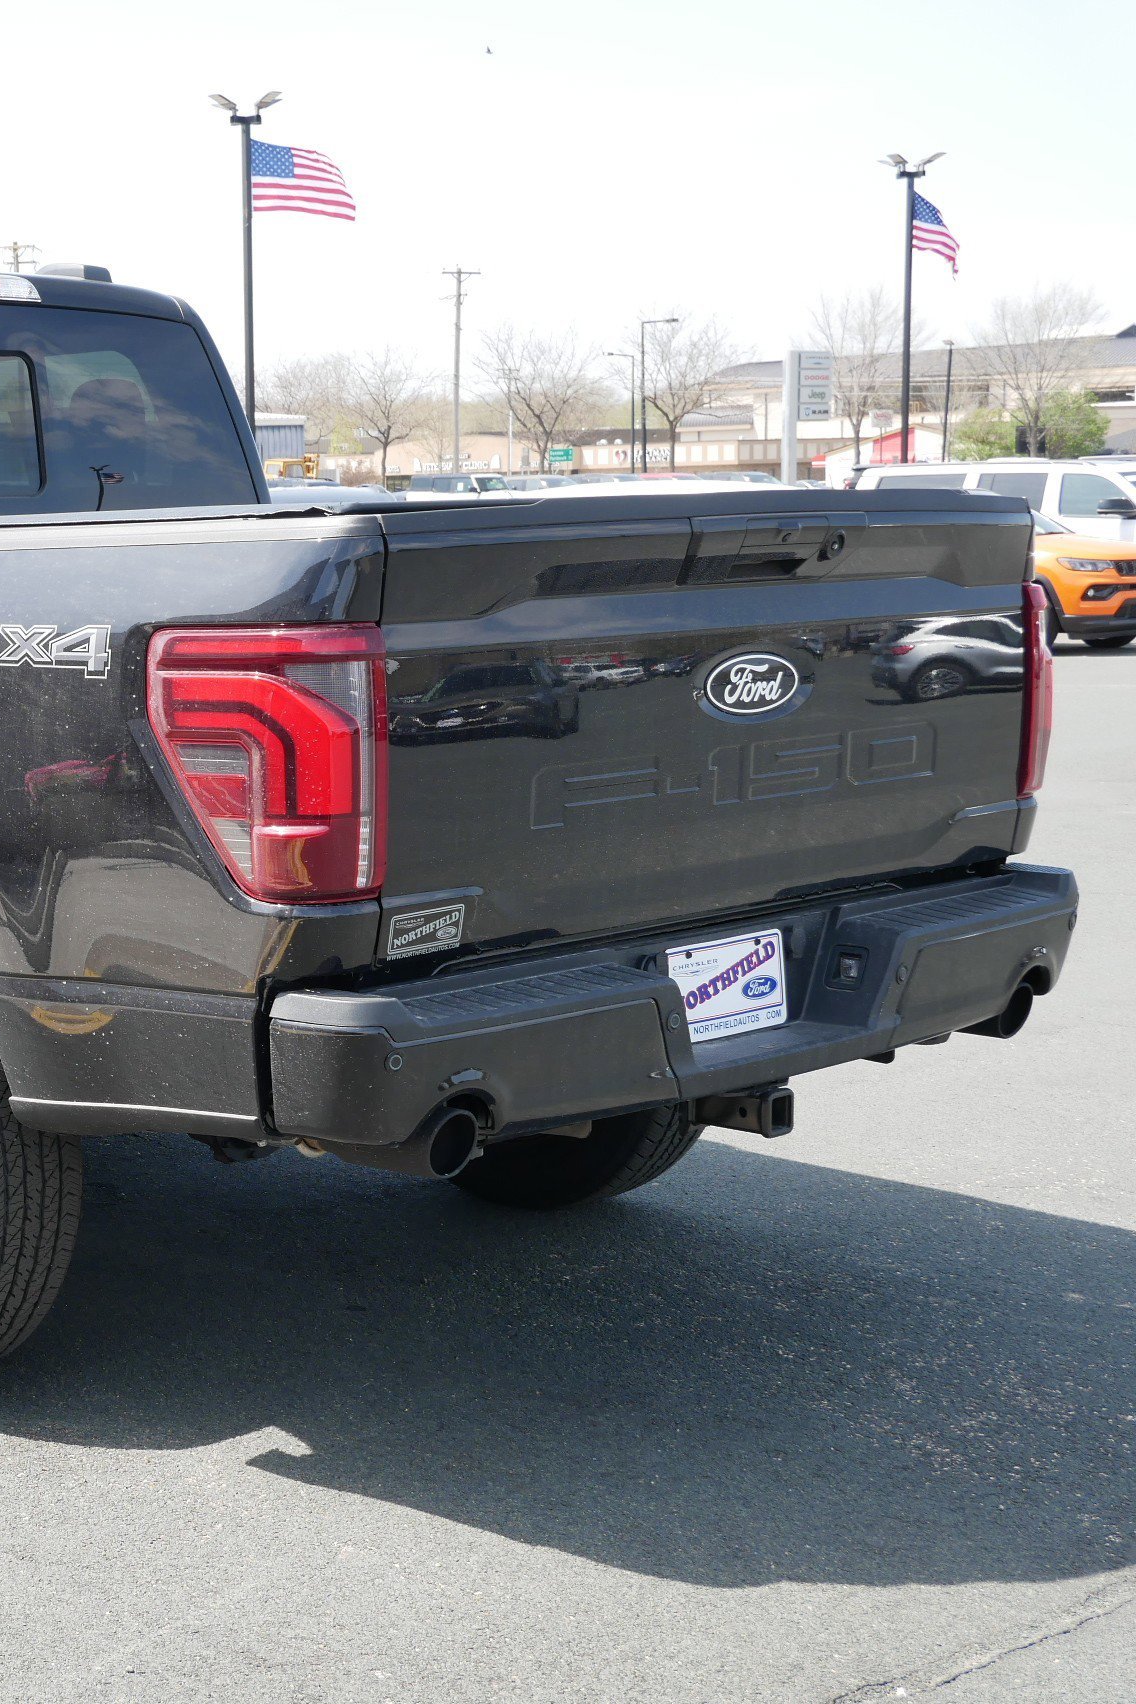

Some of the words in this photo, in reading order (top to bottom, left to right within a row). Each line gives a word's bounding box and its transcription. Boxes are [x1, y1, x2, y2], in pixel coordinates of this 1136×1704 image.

[808, 389, 826, 401] Jeep
[724, 663, 783, 703] Ford
[529, 720, 939, 830] F-150
[393, 911, 460, 949] NORTHFIELD
[386, 942, 461, 961] WWW.NORTHFIELDAUTOS.COM
[672, 958, 719, 972] CHRYSLER
[683, 940, 776, 1010] ORTHFIELD
[747, 979, 771, 995] Ford
